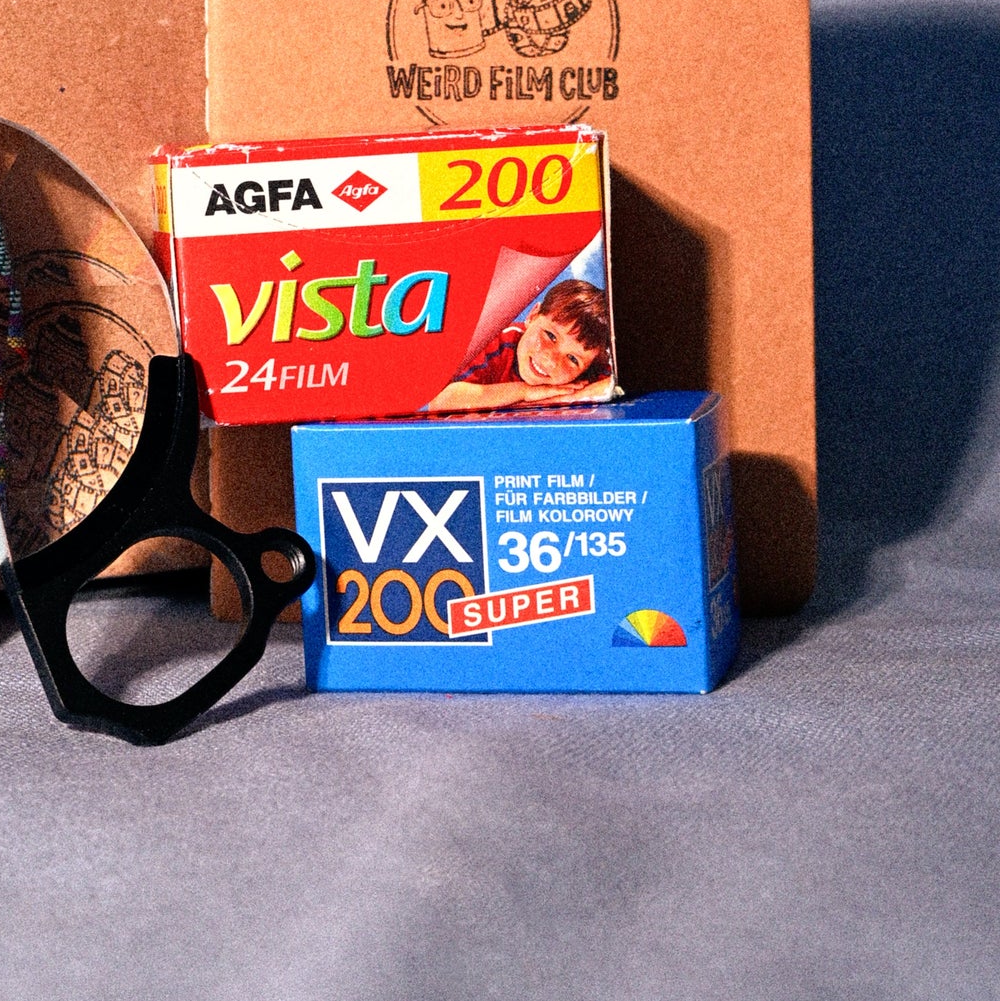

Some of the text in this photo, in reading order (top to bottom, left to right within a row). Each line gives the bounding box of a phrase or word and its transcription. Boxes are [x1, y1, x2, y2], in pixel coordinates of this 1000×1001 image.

[559, 67, 619, 100] CLUB
[204, 178, 323, 216] AGFA
[336, 182, 380, 200] Agfa
[439, 154, 574, 211] 200
[209, 249, 450, 346] vista
[494, 475, 541, 489] PRINT
[547, 474, 584, 488] FILM
[495, 489, 527, 506] FÜR
[533, 491, 637, 505] FARBBILDER
[331, 490, 475, 563] VX
[496, 508, 634, 523] FILM KOLOROWY
[336, 568, 476, 636] 200
[463, 585, 580, 627] SUPER
